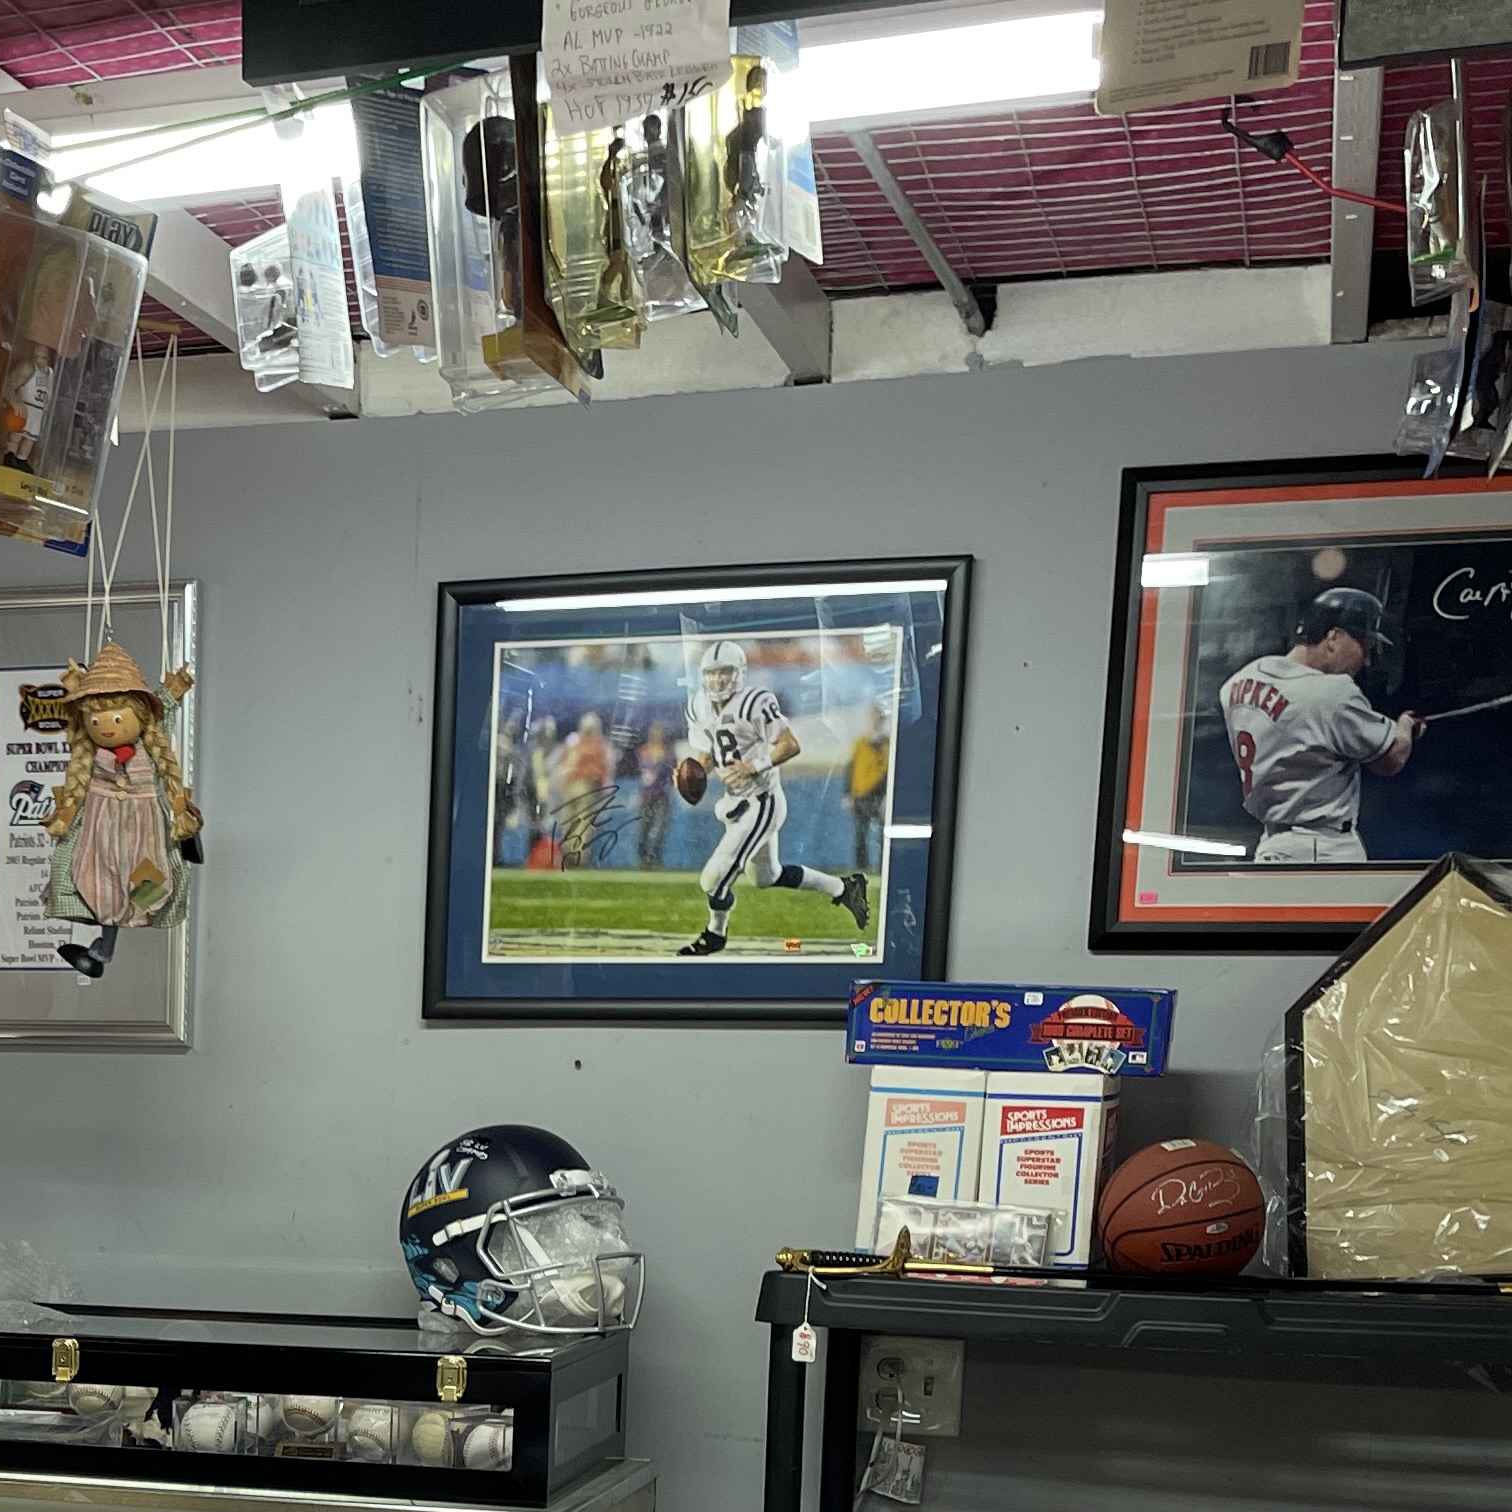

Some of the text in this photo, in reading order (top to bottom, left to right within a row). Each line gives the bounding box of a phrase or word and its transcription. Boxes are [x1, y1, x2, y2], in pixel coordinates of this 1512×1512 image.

[563, 30, 583, 51] AL
[592, 27, 624, 49] MVP
[6, 741, 60, 755] SUPER BOWL
[869, 996, 1012, 1029] COLLECTOR'S
[1065, 1024, 1134, 1041] COMPLETE SET
[891, 1101, 932, 1115] SPORTS
[890, 1110, 960, 1124] IMPRESSIONS
[1007, 1109, 1049, 1122] SPORTS
[1005, 1116, 1078, 1133] IMPRESSIONS
[1016, 1156, 1061, 1165] SUPERSTAR
[1024, 1149, 1055, 1158] SPORTS
[1016, 1171, 1060, 1179] COLLECTOR
[1019, 1164, 1057, 1172] FIGURINE
